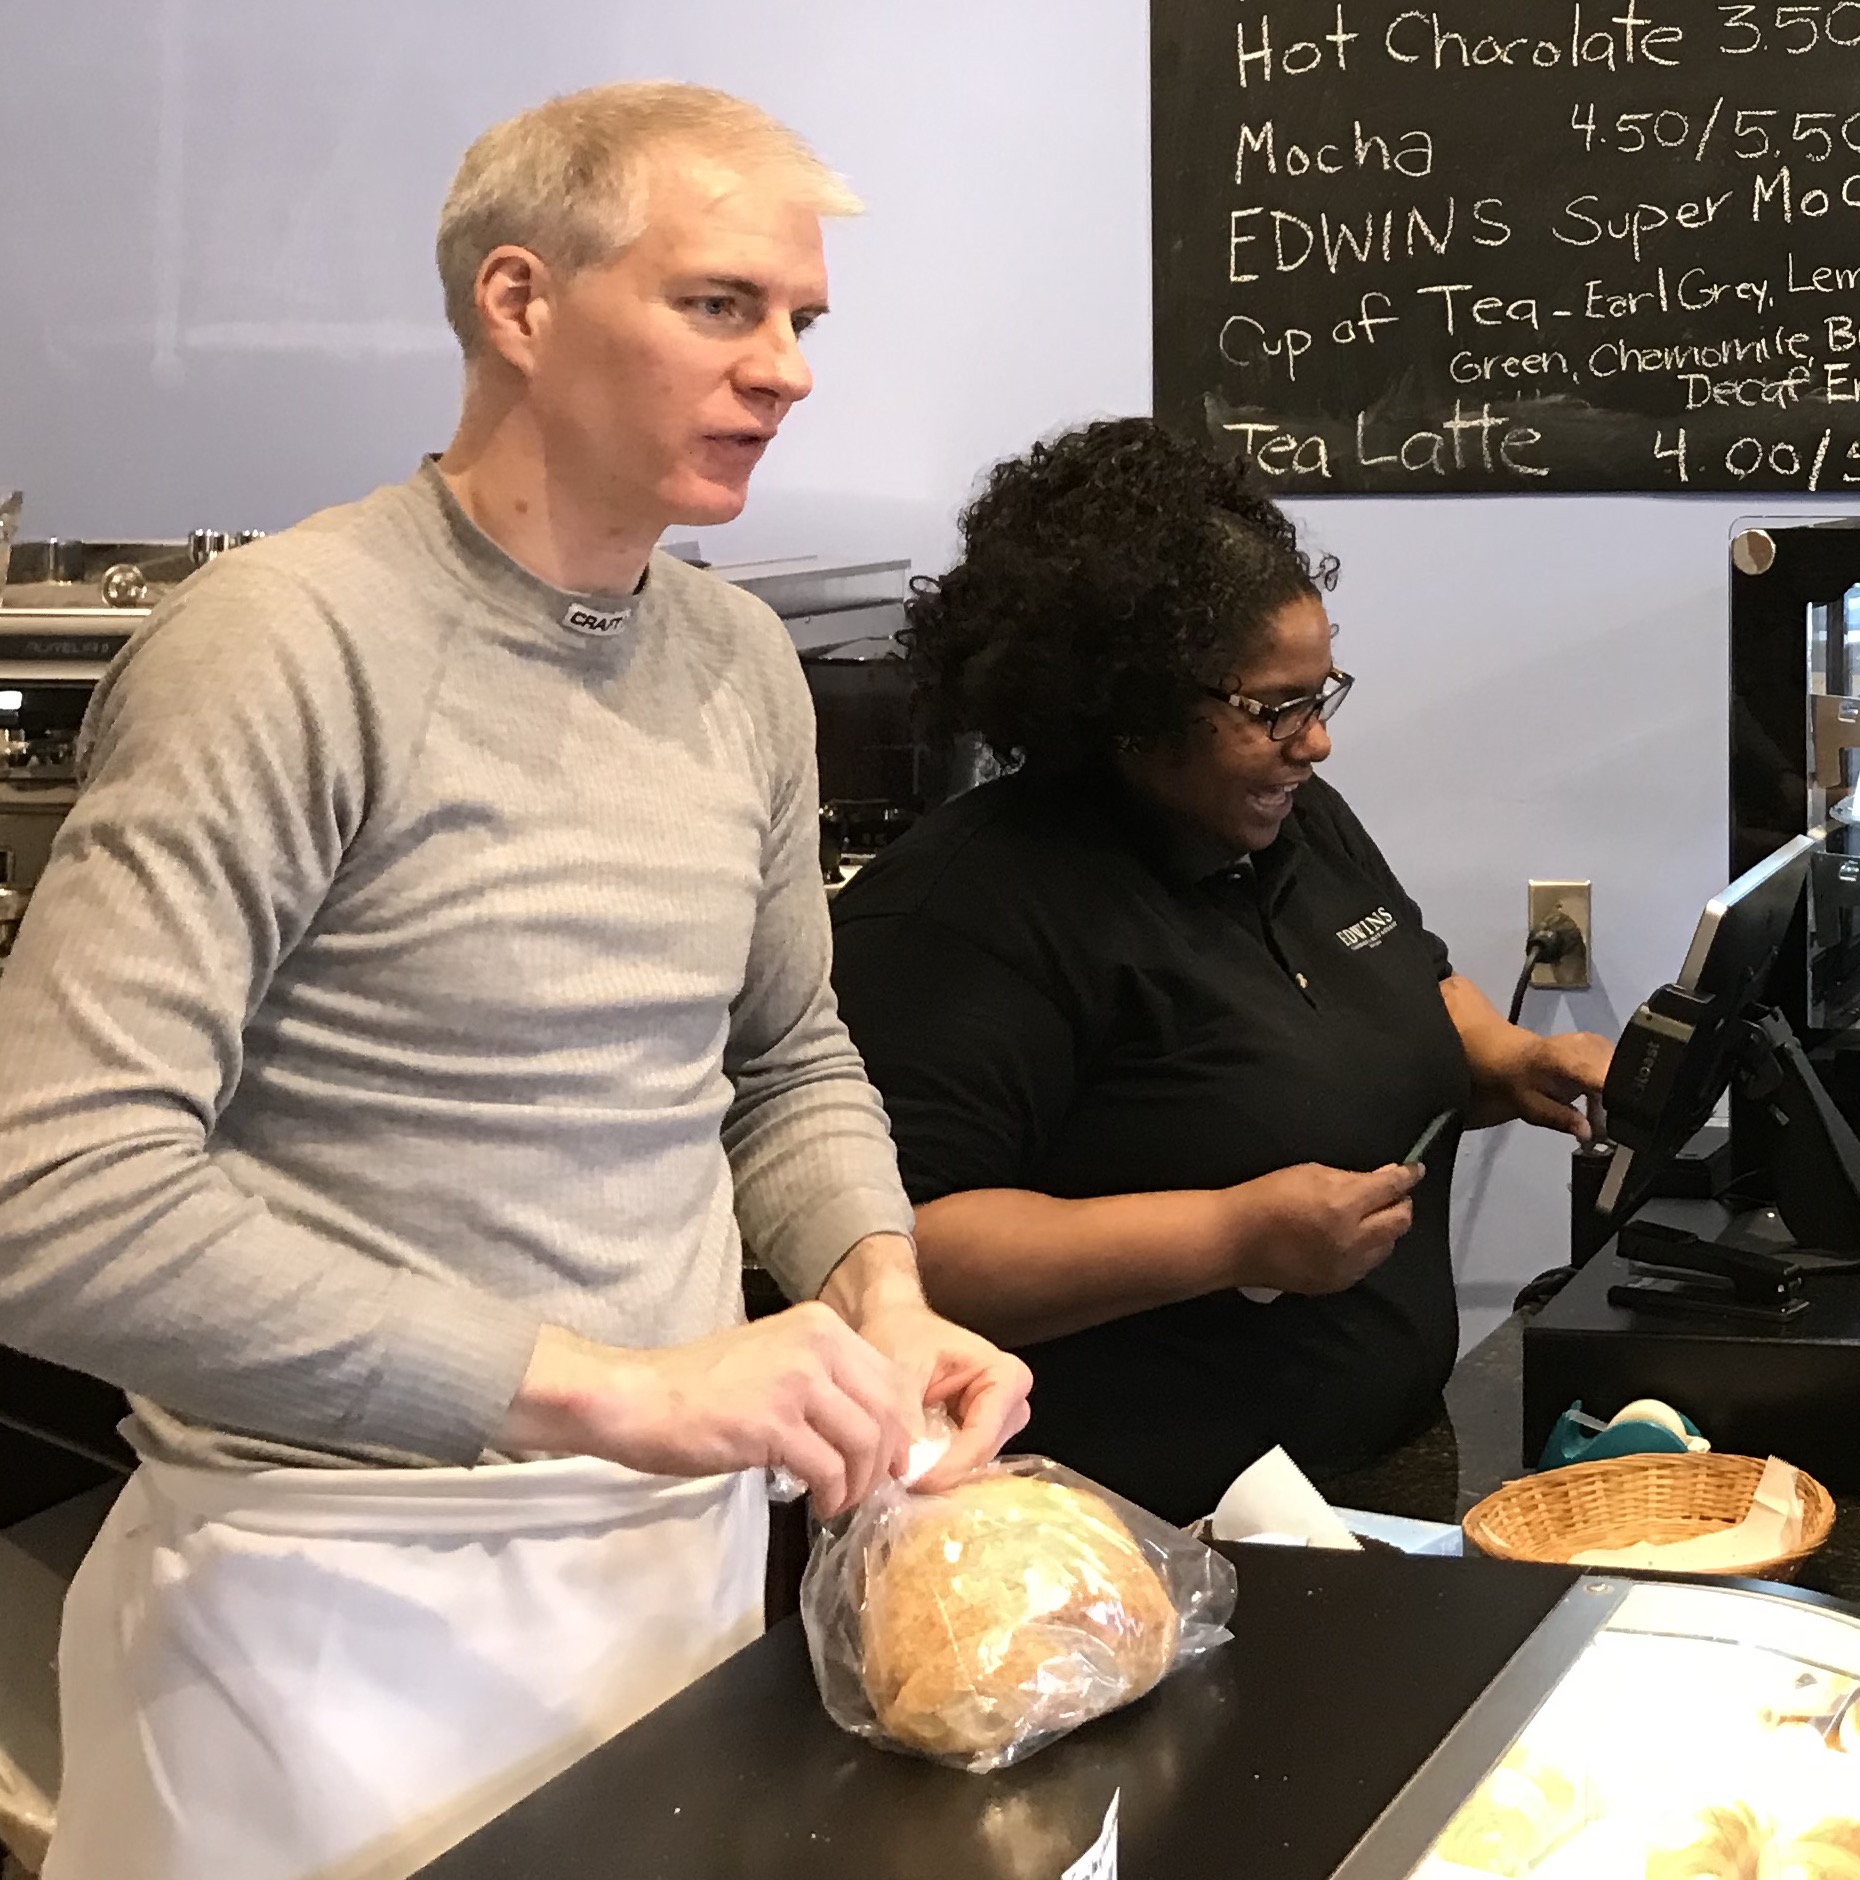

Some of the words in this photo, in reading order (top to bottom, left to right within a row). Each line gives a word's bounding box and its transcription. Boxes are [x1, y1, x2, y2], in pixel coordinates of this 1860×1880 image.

[1236, 4, 1359, 88] Hot
[1386, 0, 1682, 70] Chocolate
[1234, 120, 1432, 185] Mocha
[1229, 197, 1511, 283] EDWINS
[1552, 191, 1733, 261] Super
[1219, 315, 1312, 381] Cup
[1332, 292, 1399, 344] of
[1417, 284, 1538, 335] Tea
[1585, 267, 1667, 319] Earl
[1677, 366, 1810, 410] Decaf
[1222, 423, 1333, 479] Tea
[1355, 398, 1550, 478] Latte
[1335, 906, 1394, 947] EDWINS
